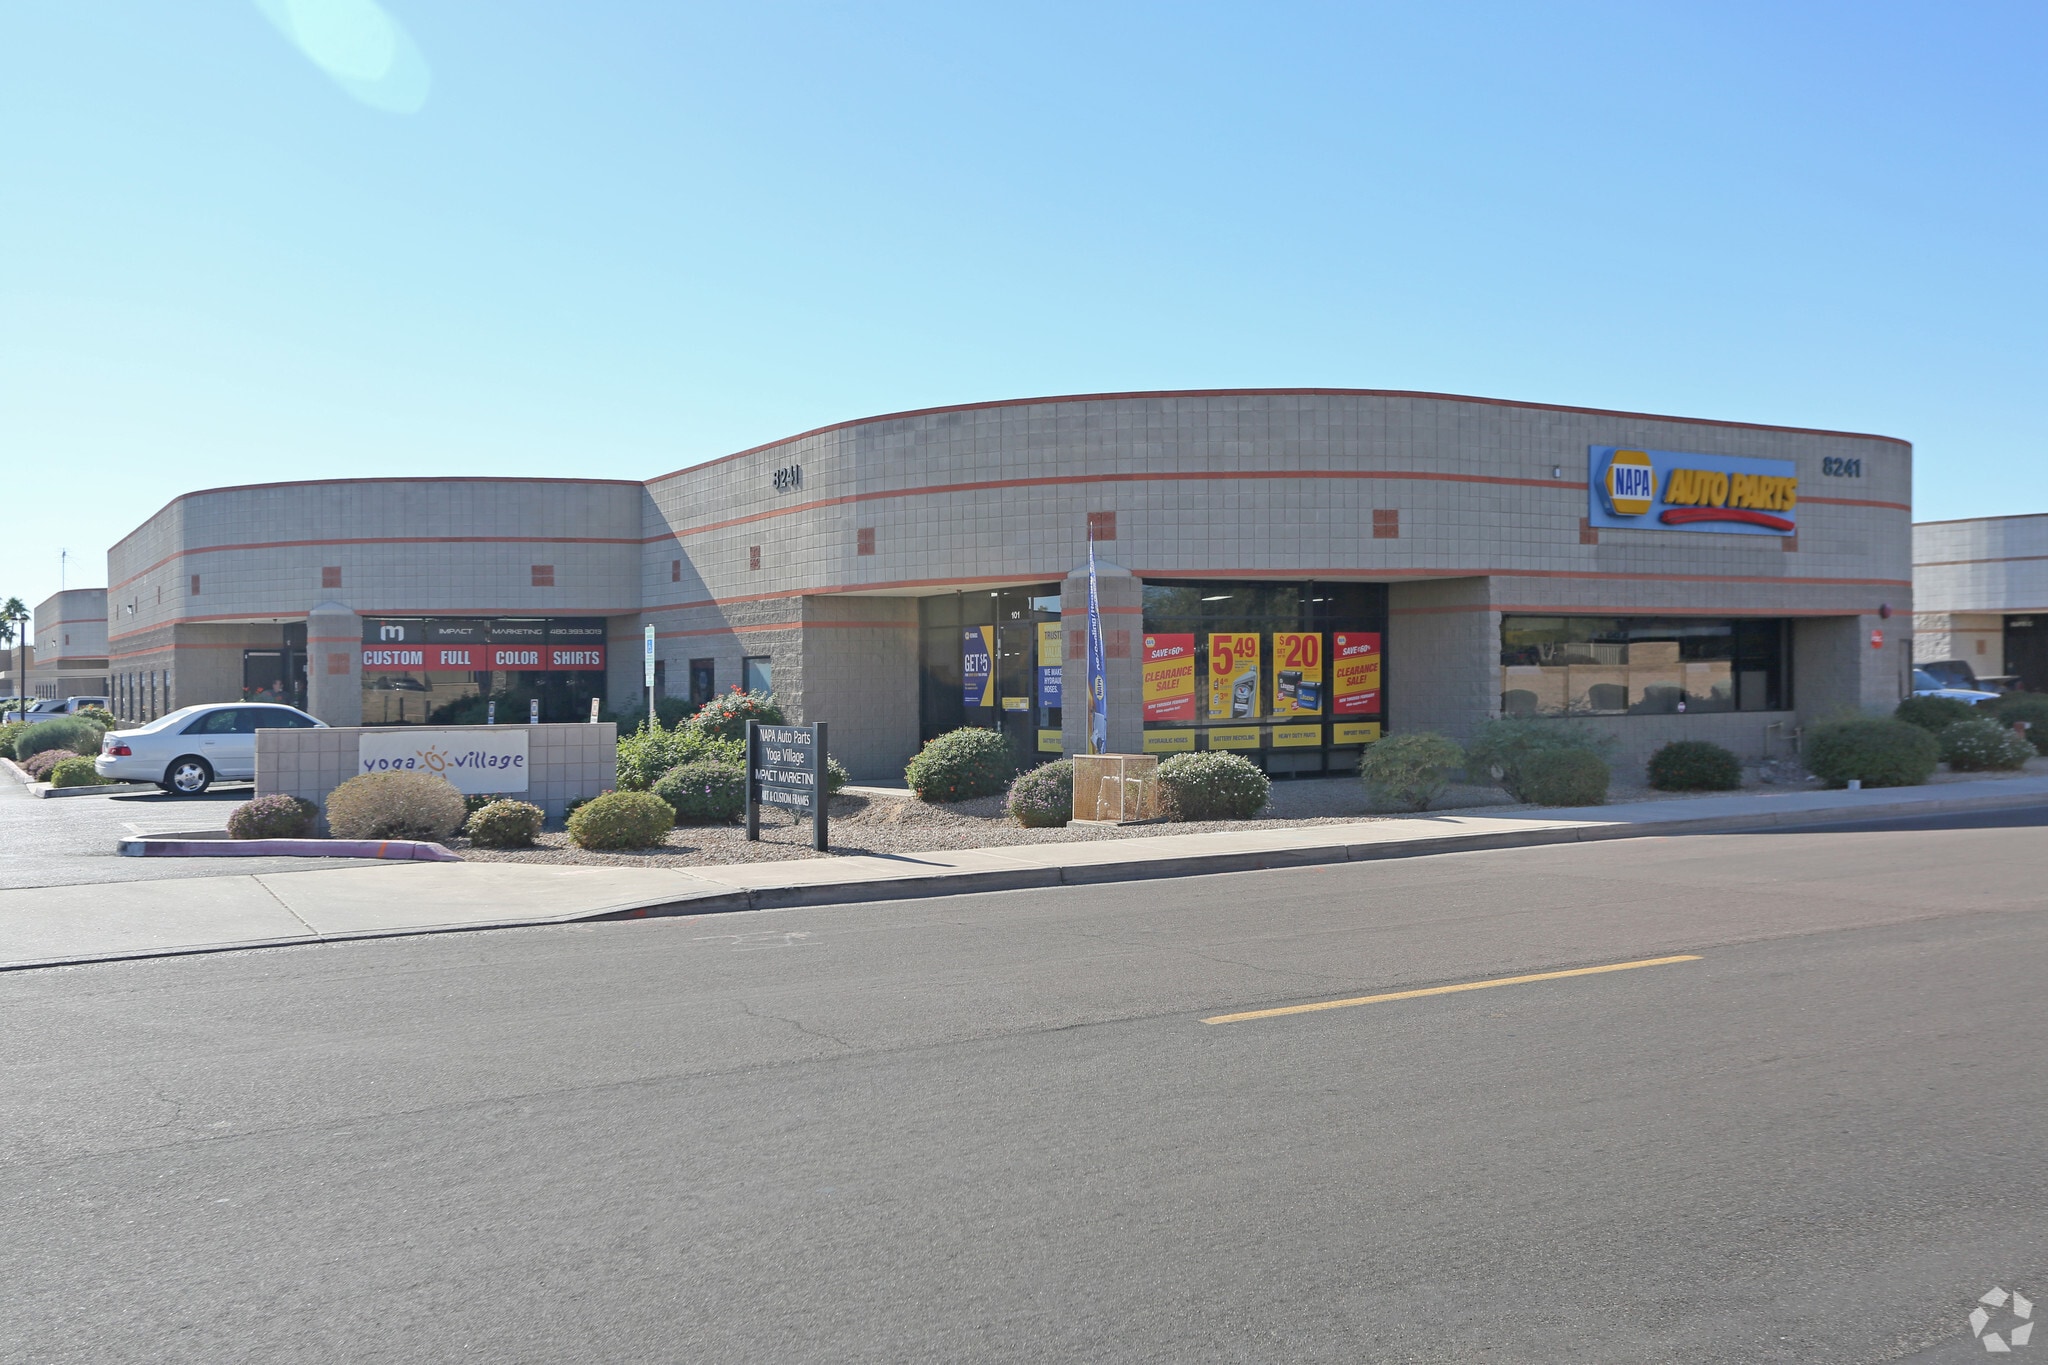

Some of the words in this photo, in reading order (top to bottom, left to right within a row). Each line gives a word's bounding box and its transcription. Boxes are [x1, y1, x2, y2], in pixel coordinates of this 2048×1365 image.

[1822, 456, 1861, 478] 8241
[774, 464, 800, 490] 8241
[1616, 468, 1650, 496] NAPA
[1664, 468, 1728, 507] AUTO
[1728, 472, 1798, 512] PARTS
[1011, 611, 1020, 619] 101
[363, 650, 423, 666] CUSTOM
[440, 650, 471, 665] FULL
[496, 651, 538, 665] COLOR
[553, 651, 600, 665] SHIRTS
[1152, 648, 1168, 659] SAVE
[1342, 646, 1357, 656] SAVE
[965, 654, 979, 672] GET
[980, 654, 988, 672] $5
[1336, 662, 1378, 678] CLEARANCE
[1145, 666, 1192, 682] CLEARANCE
[1346, 675, 1368, 686] SALE!
[1156, 678, 1180, 692] SALE!
[760, 729, 776, 742] NAPA
[778, 730, 792, 744] Auto
[794, 731, 811, 745] Parts
[364, 758, 416, 772] yoga
[454, 751, 524, 770] village
[766, 748, 781, 764] Yoga
[782, 749, 804, 766] Village
[779, 770, 814, 785] MARKETIN
[773, 791, 792, 804] CUSTOM
[792, 793, 810, 806] FRAMES
